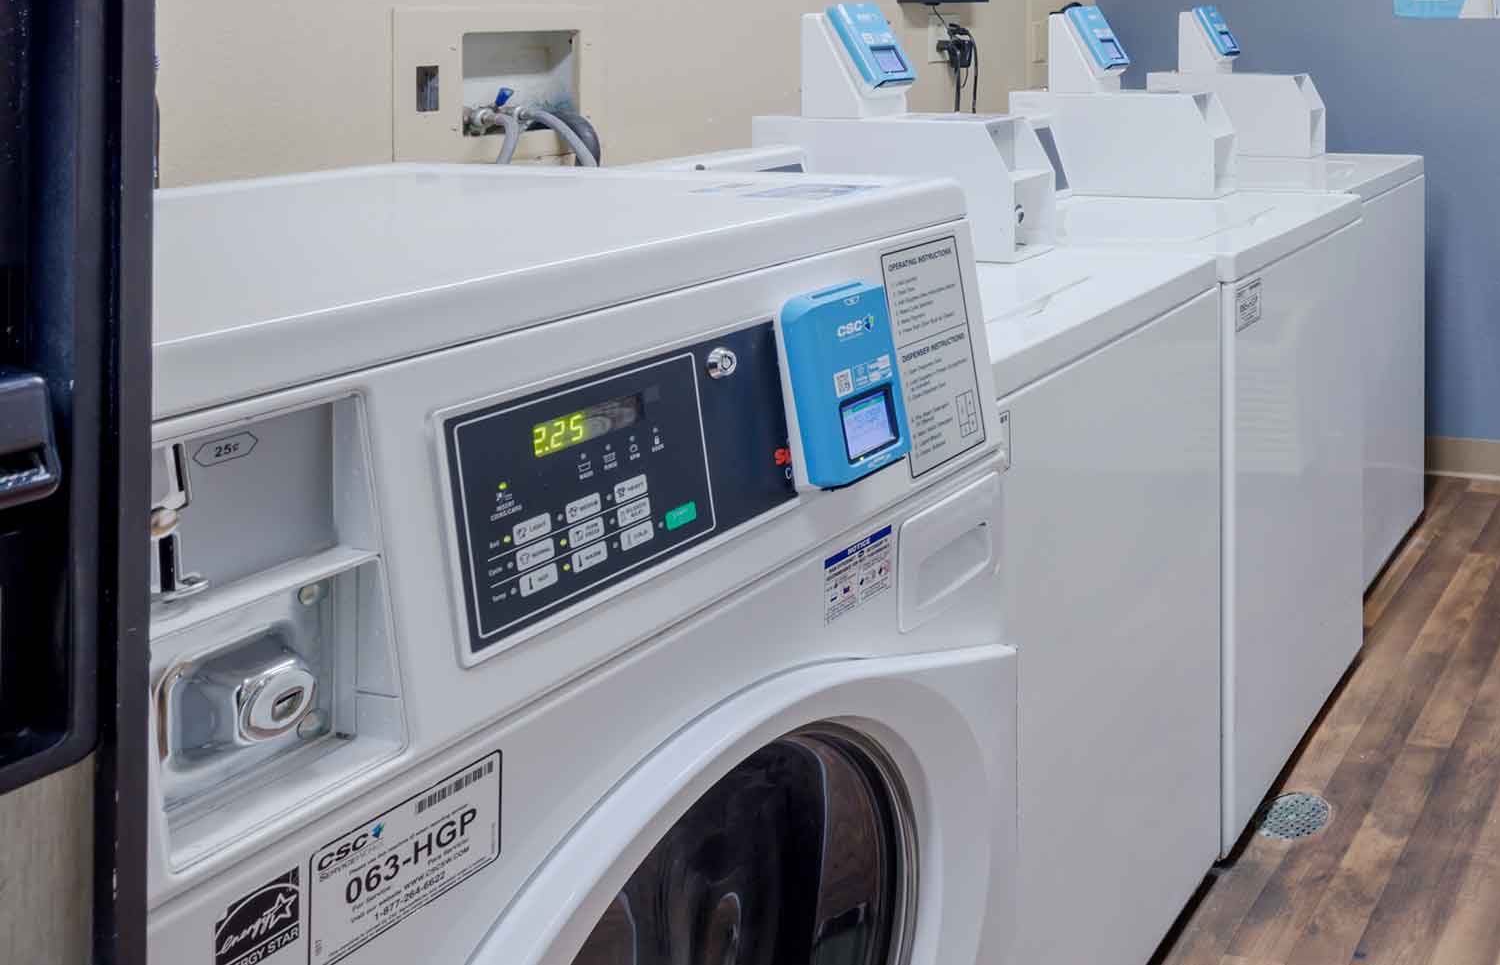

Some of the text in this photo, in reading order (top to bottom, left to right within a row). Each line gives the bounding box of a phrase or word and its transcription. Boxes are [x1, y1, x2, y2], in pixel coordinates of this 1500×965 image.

[888, 248, 952, 272] OPERATING INSTRUCTIONS
[902, 333, 965, 363] DISPENSER INSTRUCTIONS
[533, 413, 585, 457] 2.25
[848, 538, 871, 555] NOTICE
[317, 833, 369, 872] CSC
[345, 808, 477, 905] 063-HGP
[268, 927, 298, 955] STAR
